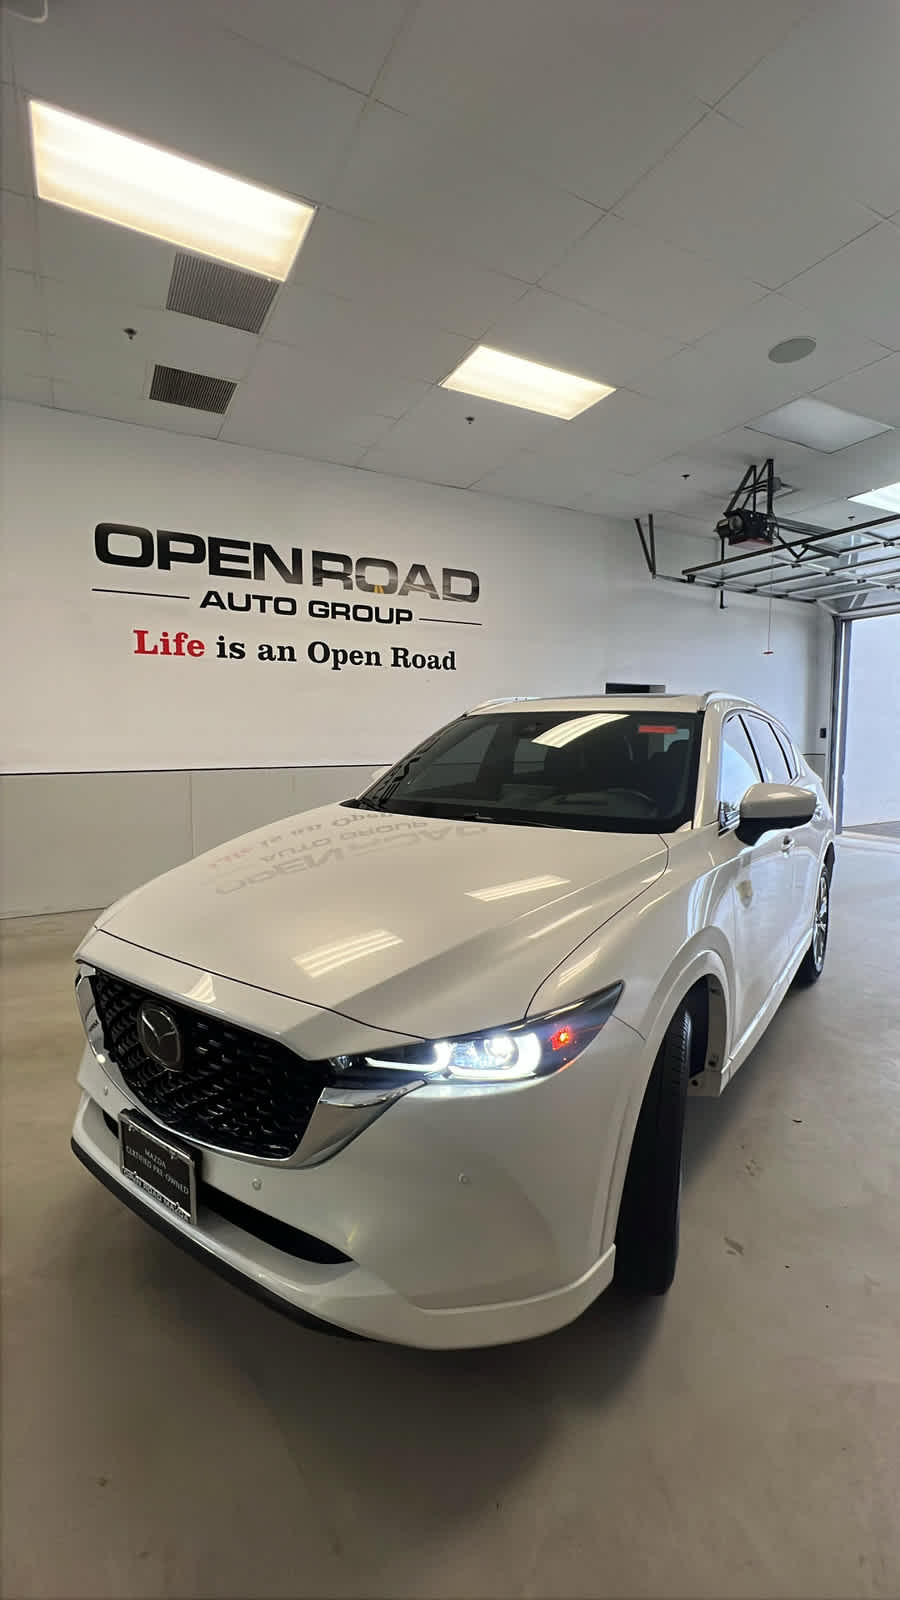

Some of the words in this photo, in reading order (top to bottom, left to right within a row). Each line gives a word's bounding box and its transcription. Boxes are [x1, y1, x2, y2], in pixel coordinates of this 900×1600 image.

[94, 522, 303, 585] OPEN
[311, 550, 480, 603] ROAD
[199, 590, 297, 616] AUTO
[307, 600, 414, 625] GROUP
[133, 629, 206, 657] Life
[216, 635, 246, 660] is
[257, 644, 297, 662] an
[307, 641, 382, 671] Open
[390, 647, 457, 671] Road
[144, 1147, 168, 1169] MAZDA
